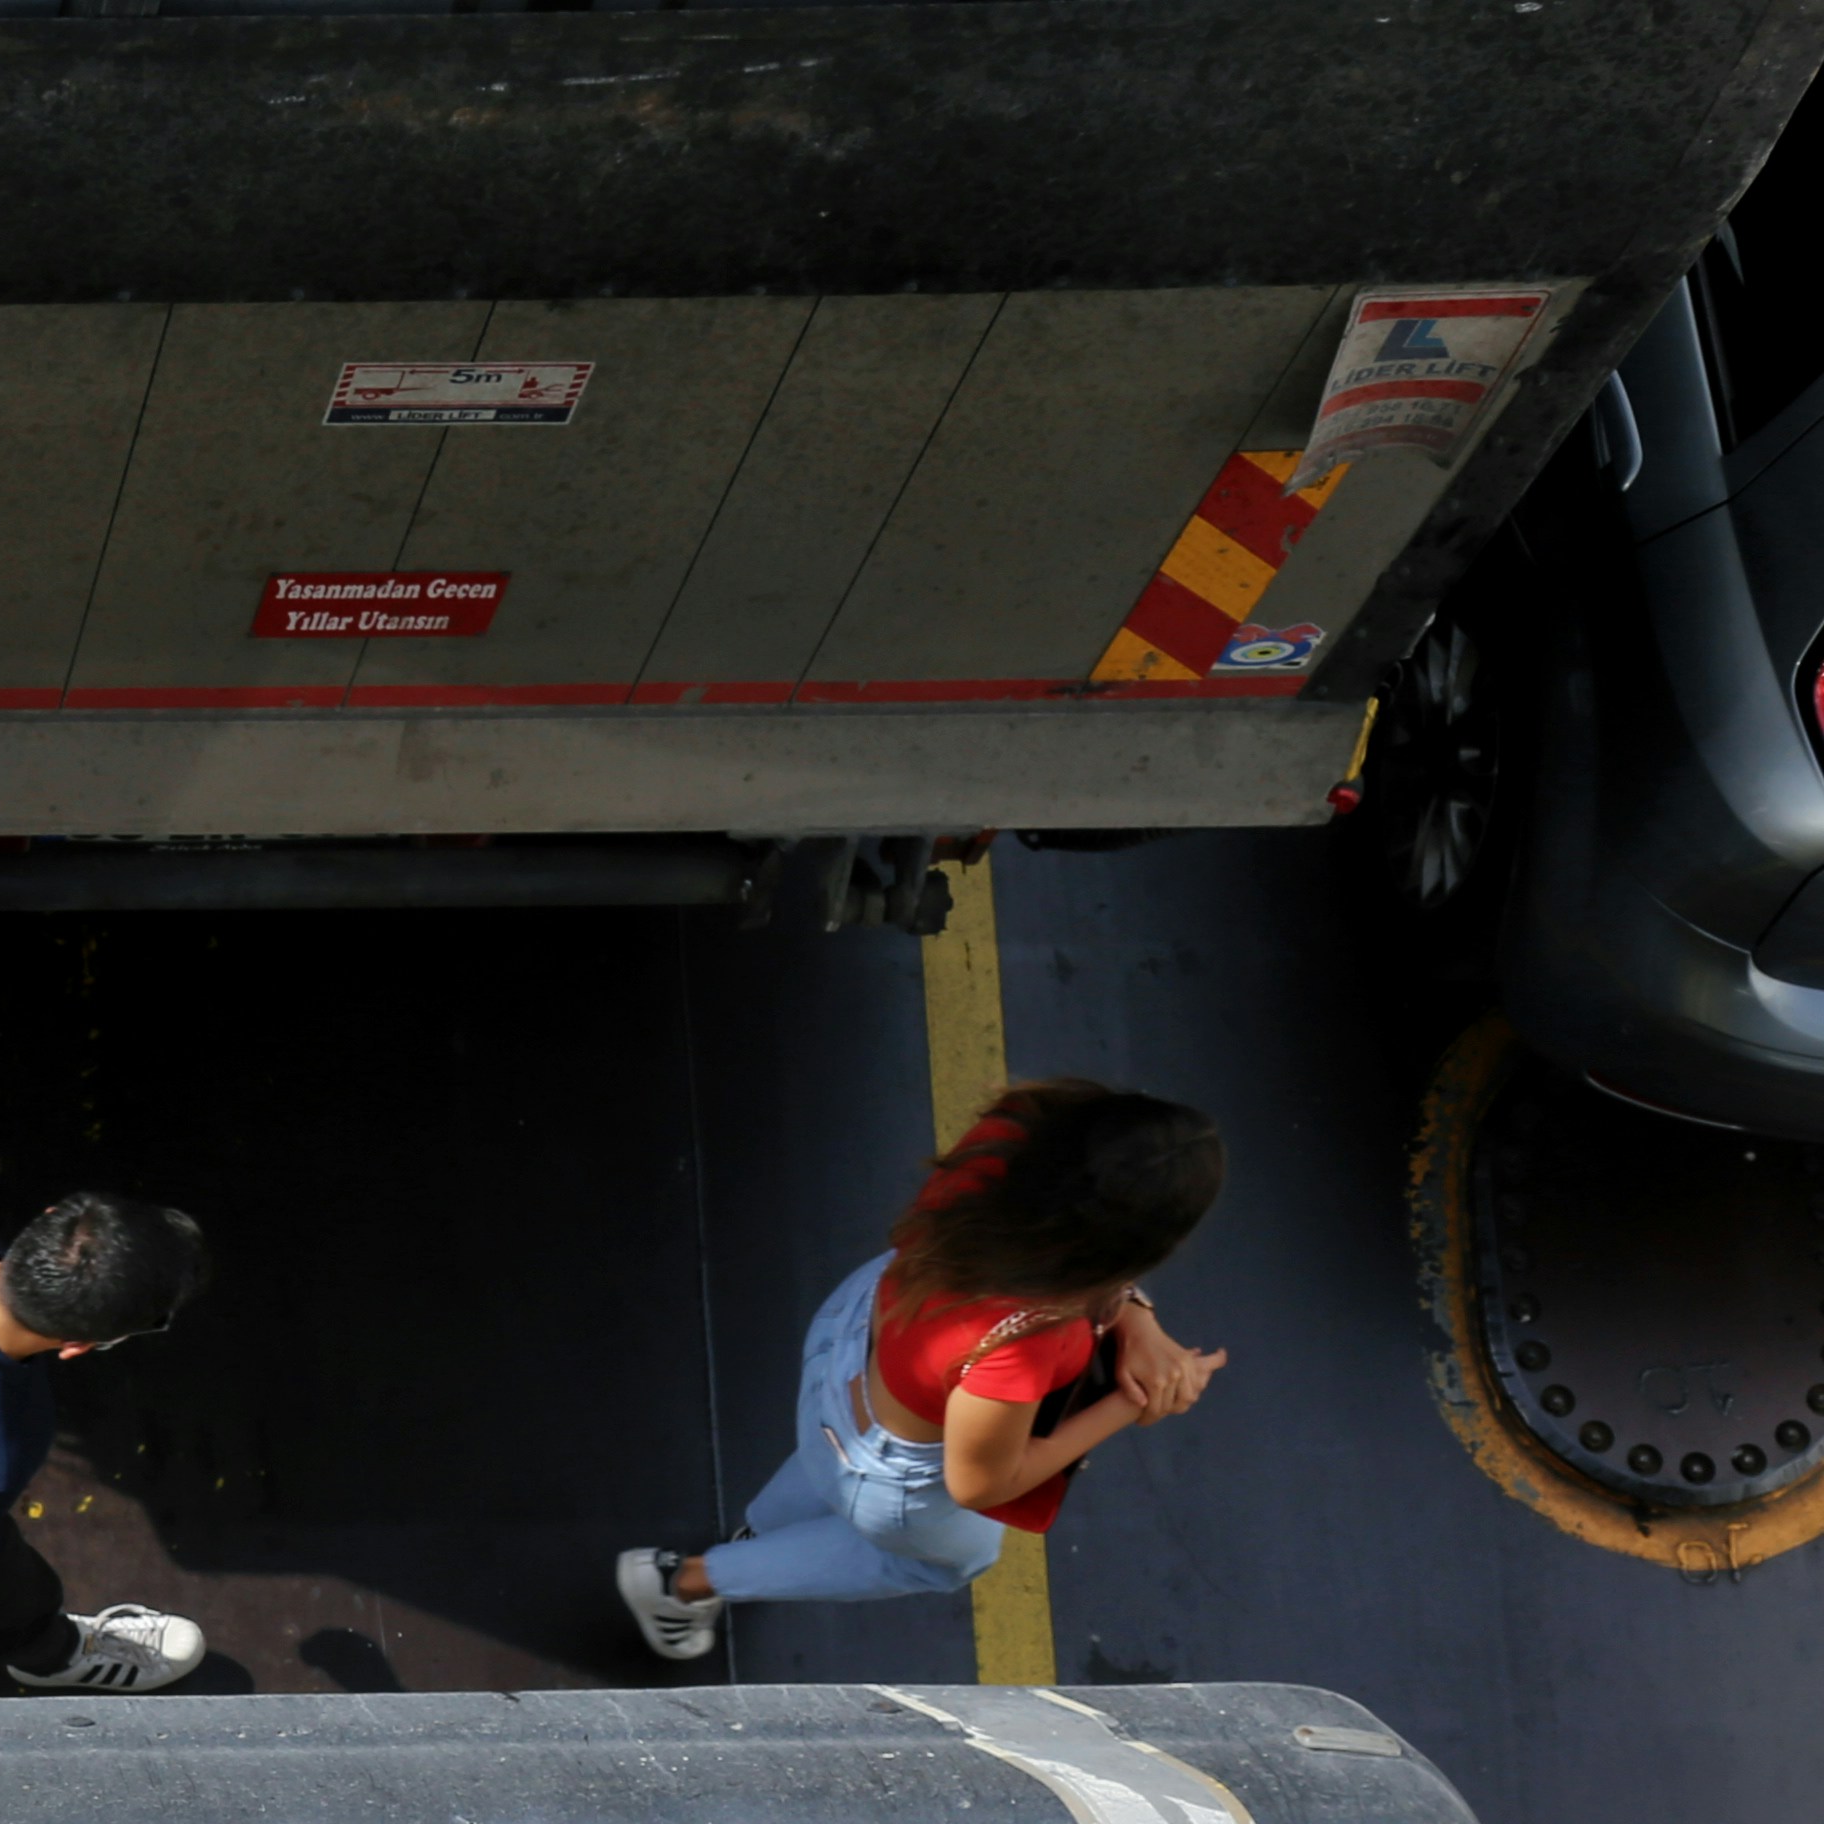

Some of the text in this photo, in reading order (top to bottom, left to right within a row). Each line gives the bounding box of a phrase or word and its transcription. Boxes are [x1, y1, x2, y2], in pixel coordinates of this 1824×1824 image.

[449, 369, 502, 384] 5m
[285, 611, 451, 632] Yıllar Utansın
